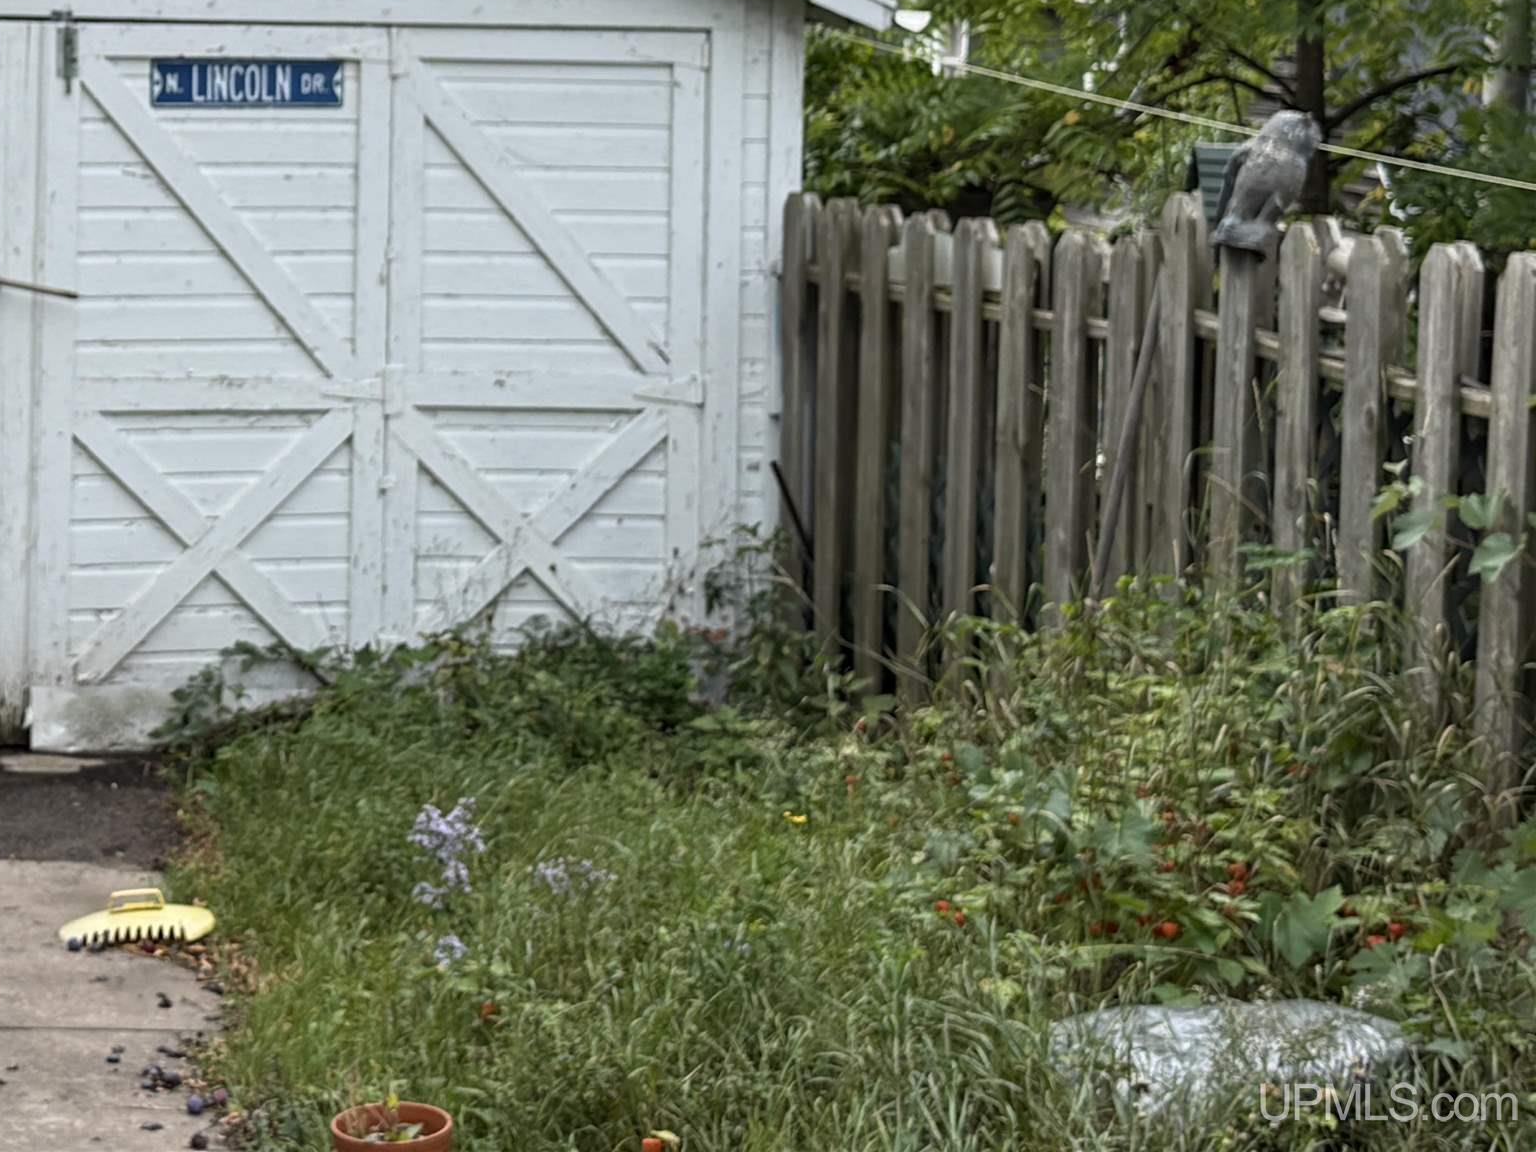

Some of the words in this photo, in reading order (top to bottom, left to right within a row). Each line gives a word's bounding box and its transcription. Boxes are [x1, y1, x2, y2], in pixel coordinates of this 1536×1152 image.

[165, 72, 184, 94] N.
[192, 63, 292, 102] LINCOLN
[300, 73, 328, 95] DR.
